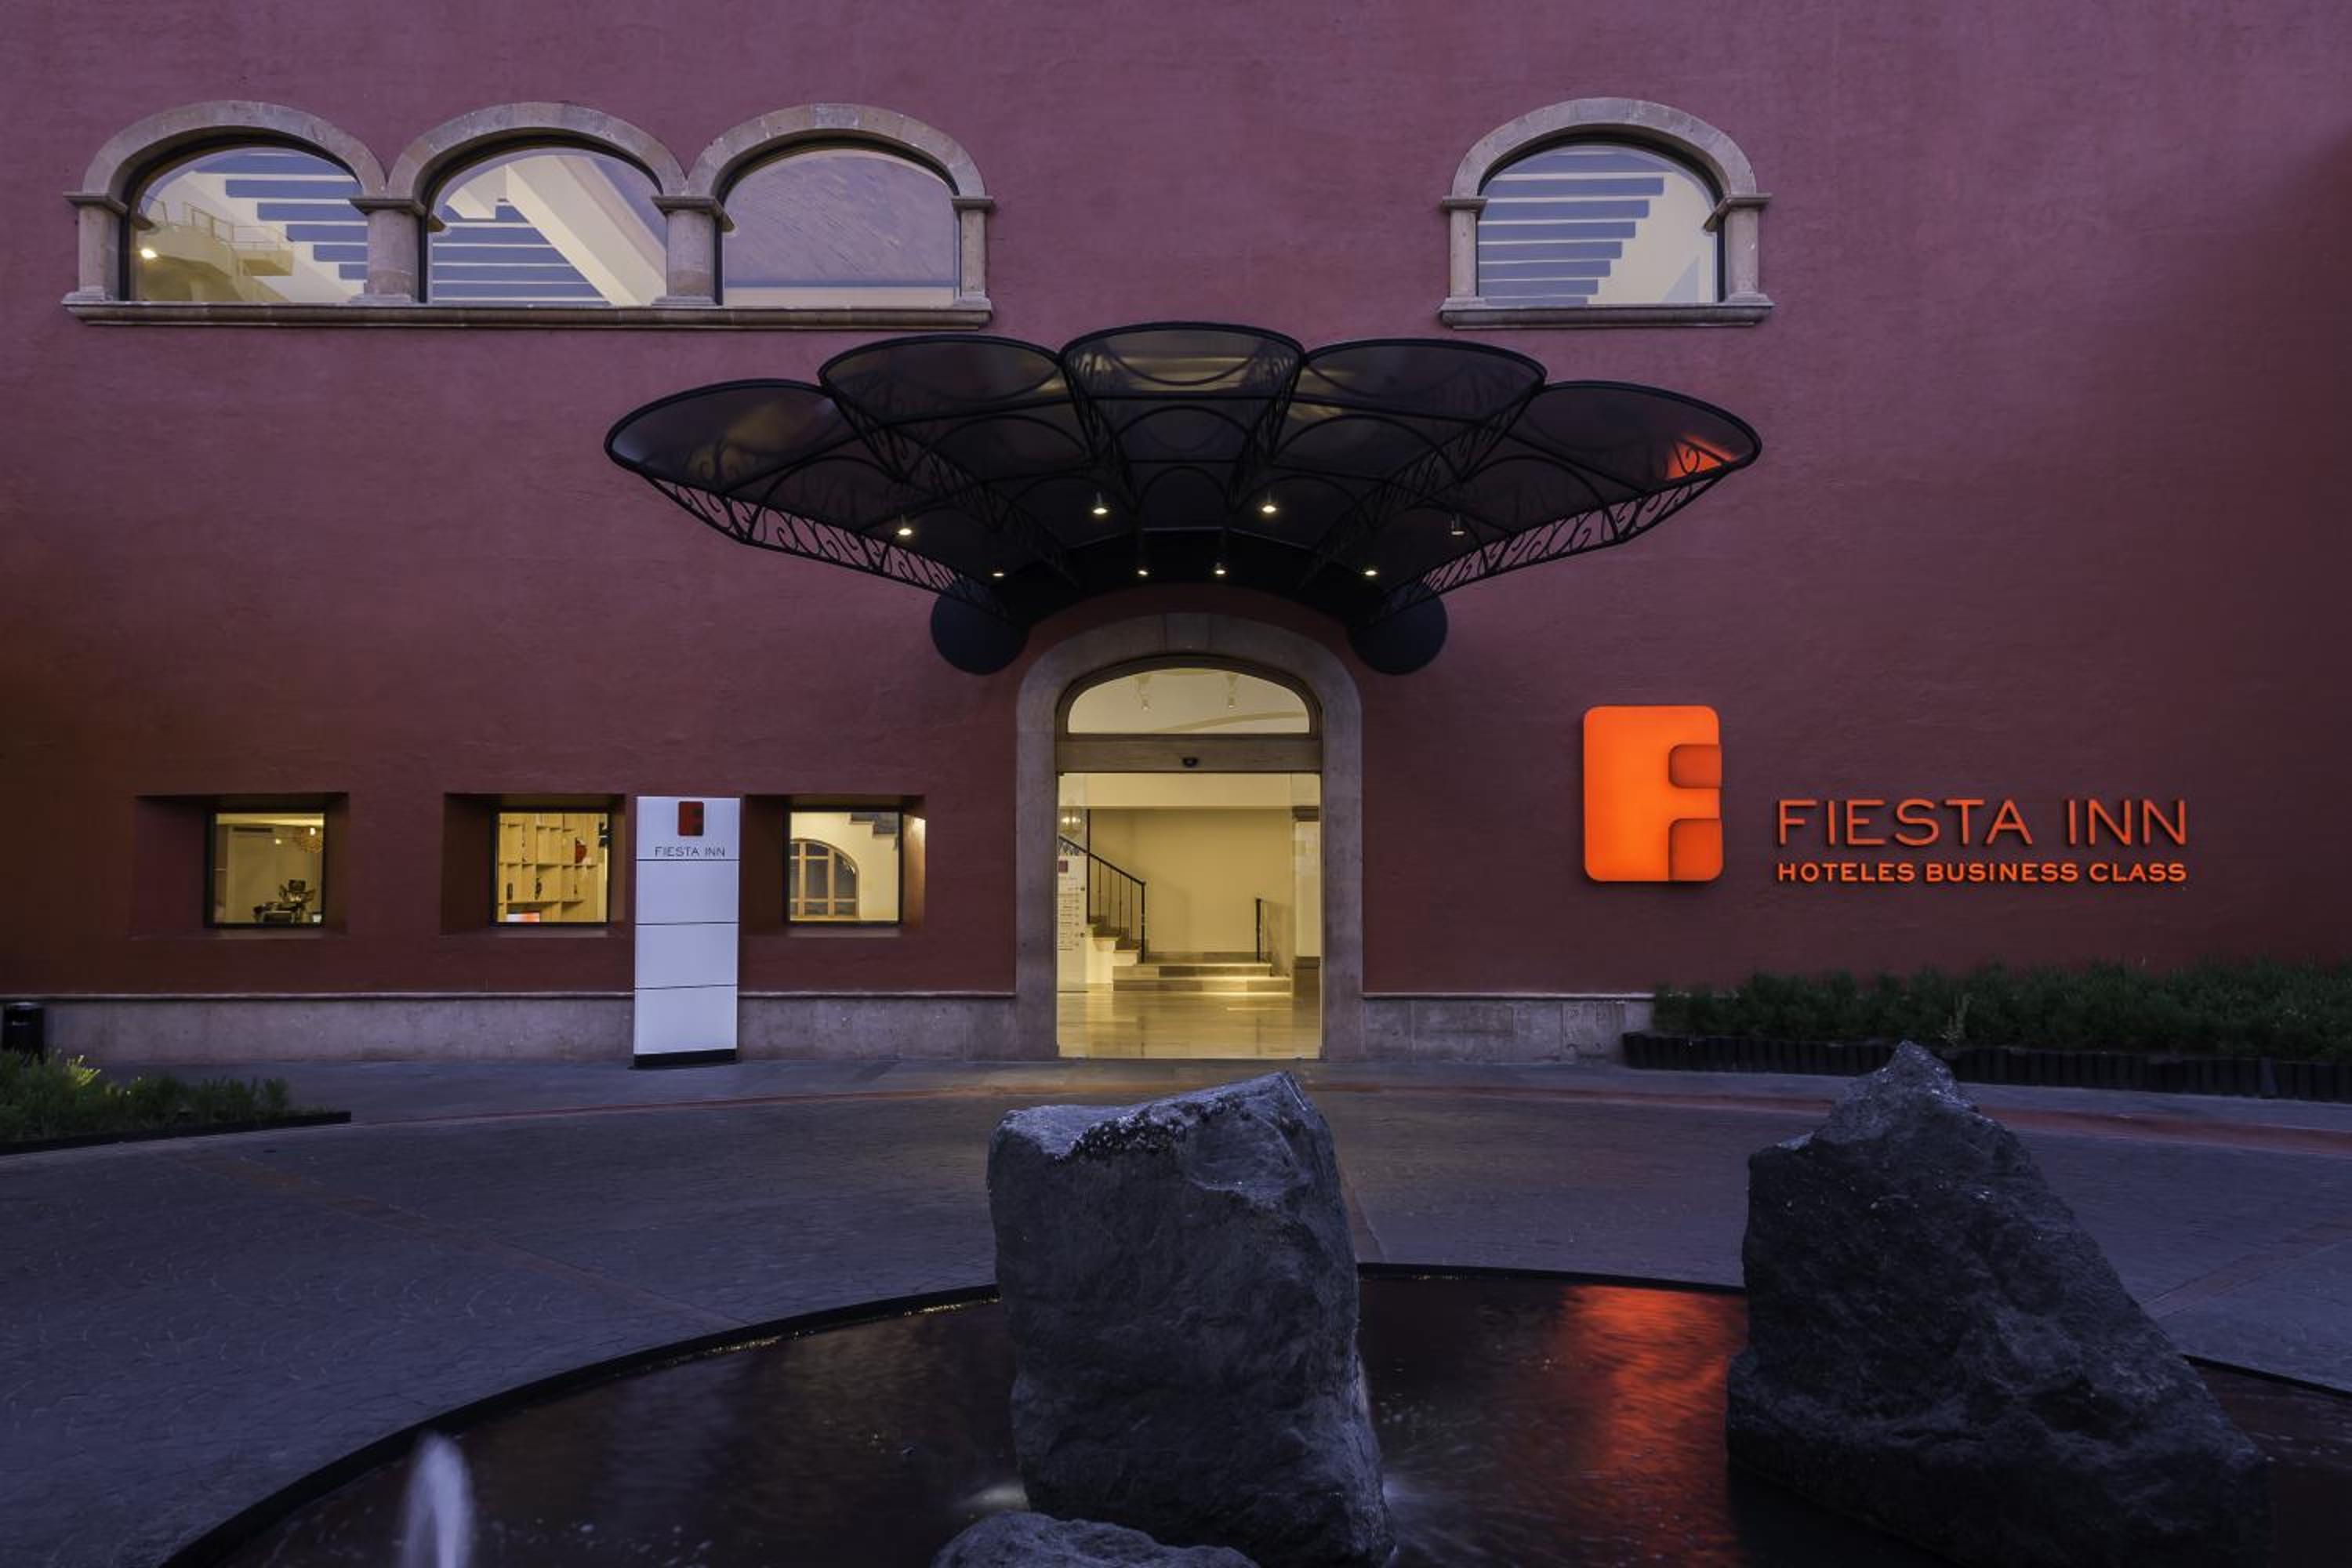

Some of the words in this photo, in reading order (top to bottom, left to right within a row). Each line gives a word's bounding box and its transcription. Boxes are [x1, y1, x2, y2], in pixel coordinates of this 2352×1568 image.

[1776, 797, 2034, 847] FIESTA
[2065, 797, 2187, 847] INN
[655, 846, 700, 857] FIESTA
[705, 846, 725, 857] INN
[1777, 862, 1916, 883] HOTELES
[1925, 862, 2080, 883] BUSINESS
[2089, 862, 2187, 883] CLASS
